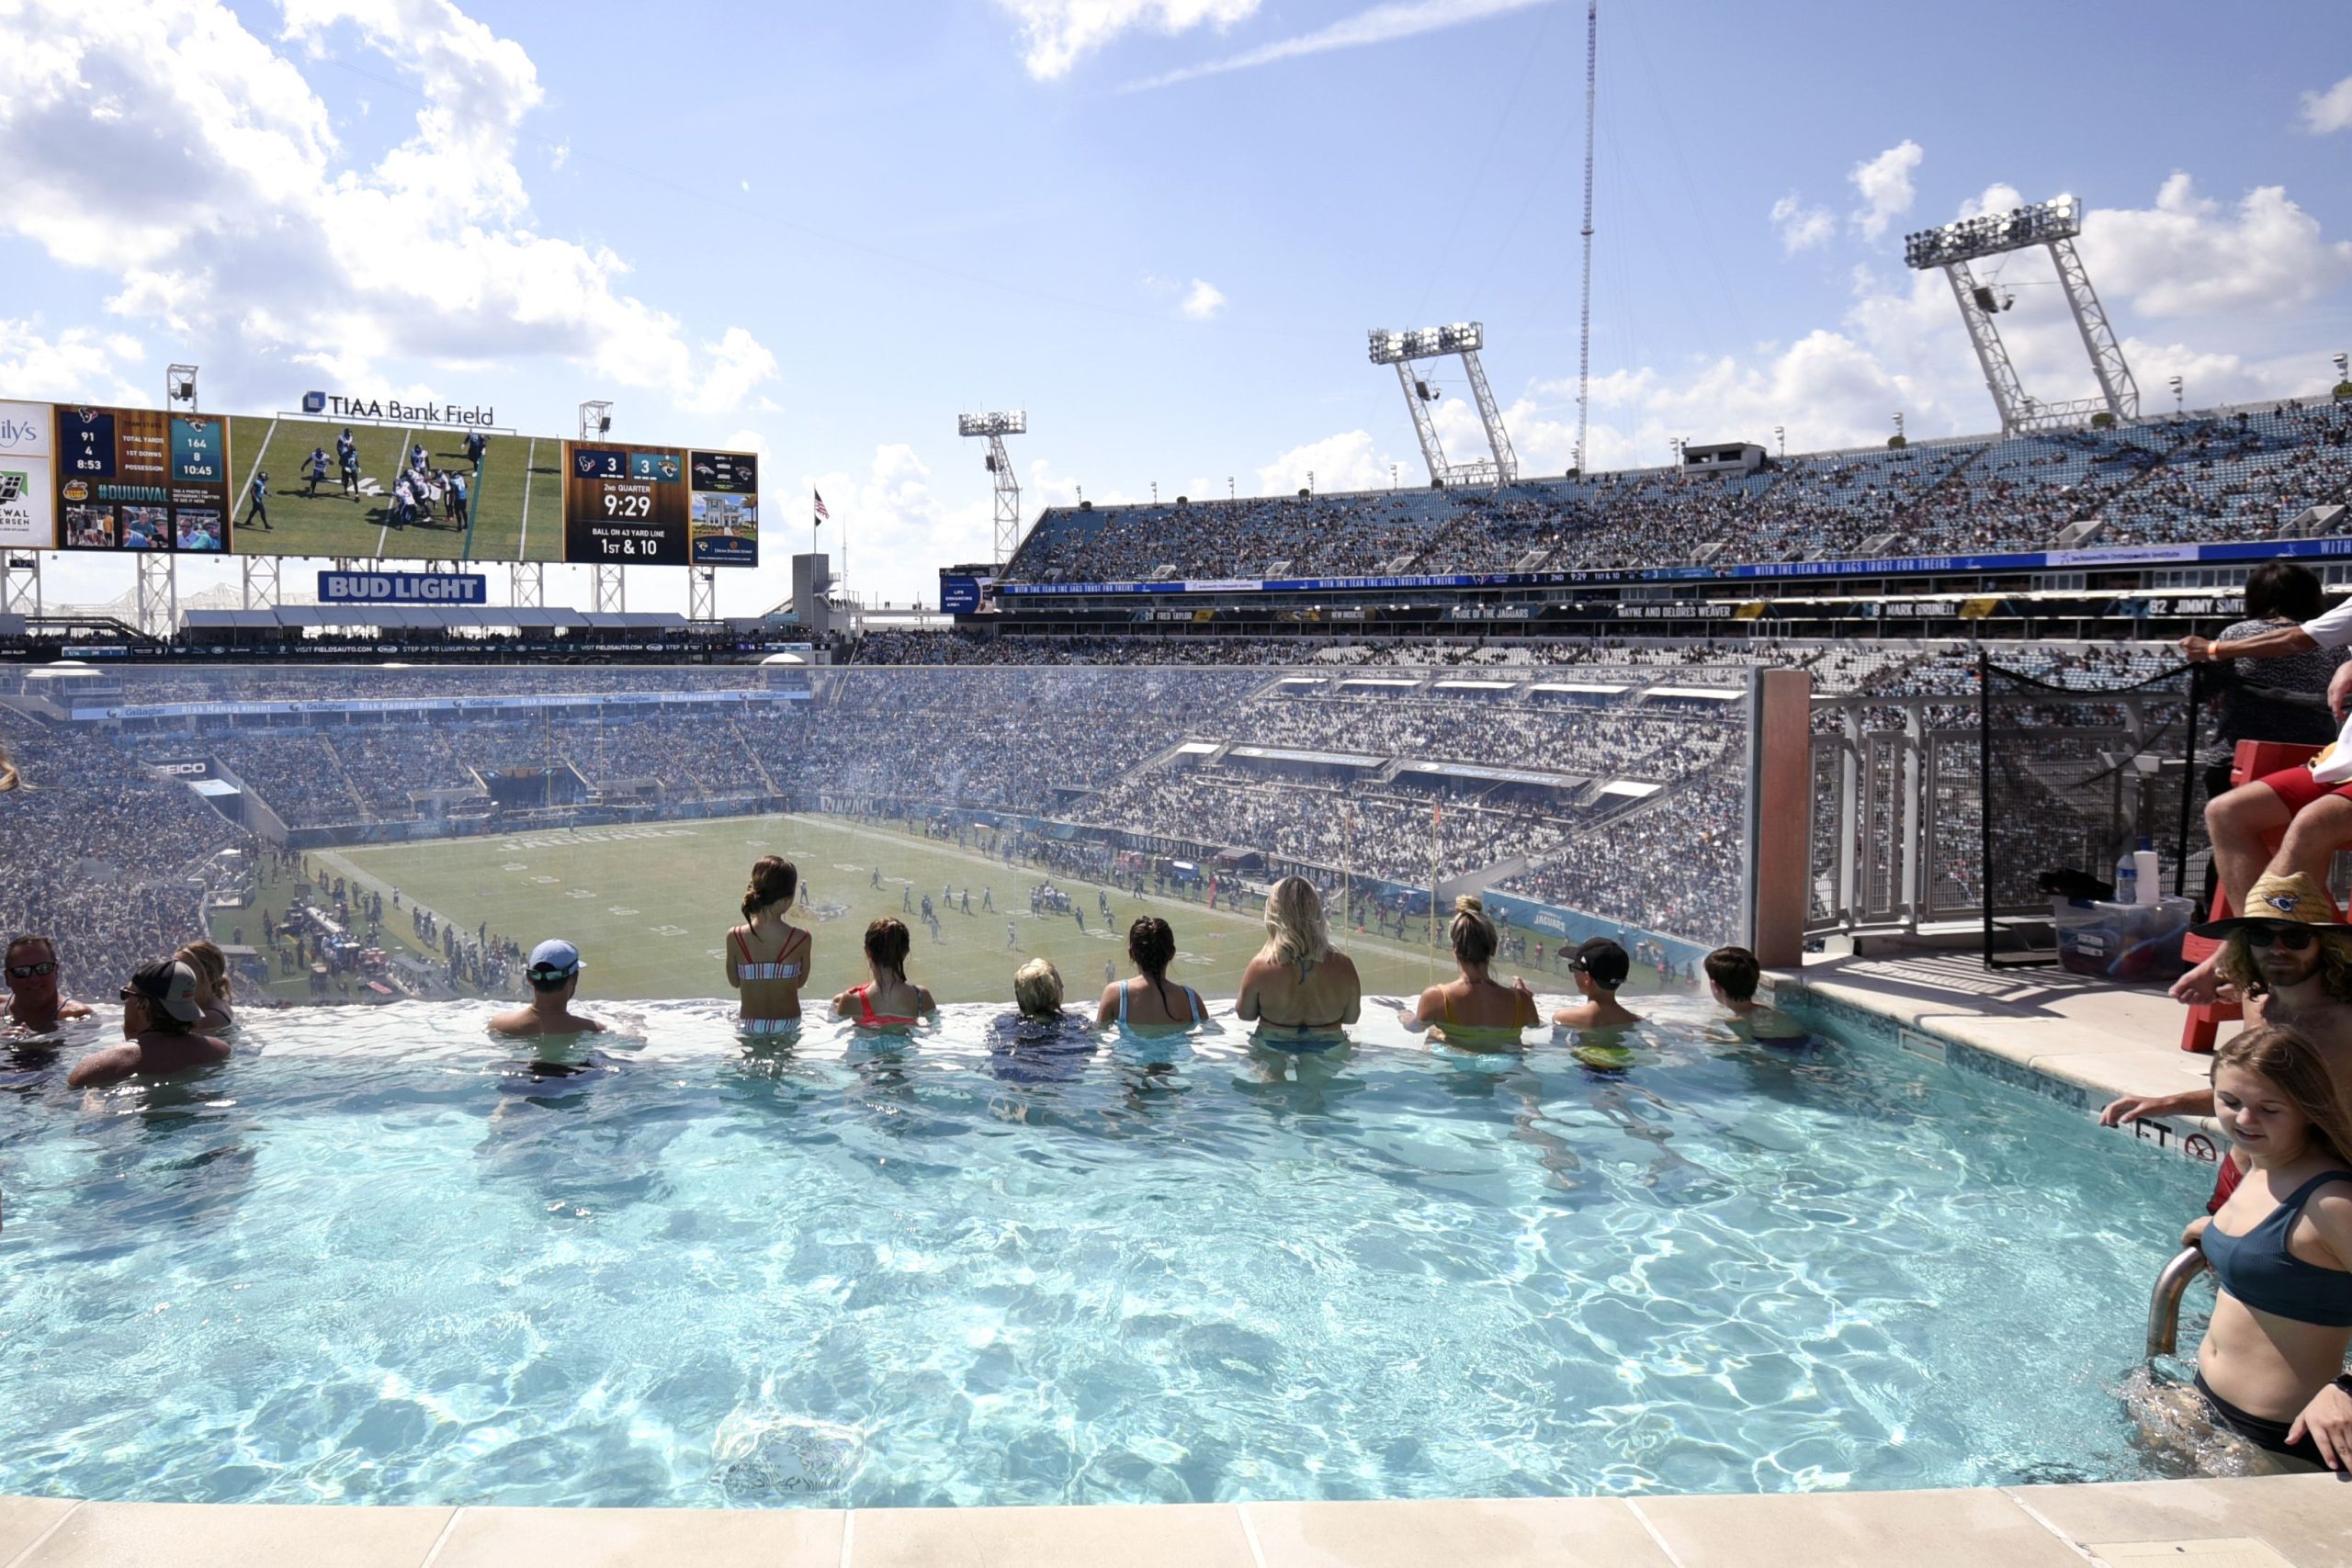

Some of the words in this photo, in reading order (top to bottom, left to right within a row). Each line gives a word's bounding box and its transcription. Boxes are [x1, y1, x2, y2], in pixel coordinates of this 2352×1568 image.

[328, 396, 383, 417] TIAA
[389, 400, 441, 422] Bank
[447, 404, 493, 425] Field
[81, 432, 95, 441] 91
[187, 438, 207, 448] 164
[85, 446, 93, 456] 4
[193, 452, 201, 461] 8
[76, 459, 102, 469] 8:53
[125, 464, 164, 472] POSSESSION
[607, 457, 617, 472] 3
[640, 459, 650, 474] 3
[184, 466, 212, 476] 10:45
[97, 484, 169, 502] #DUUUVAL
[617, 484, 651, 493] QUARTER
[605, 494, 650, 517] 9:29
[592, 527, 609, 536] BALL
[610, 528, 621, 536] ON
[630, 529, 649, 537] YARD
[650, 530, 665, 538] LINE
[601, 539, 621, 554] 1ST
[623, 540, 635, 555] &
[639, 540, 657, 555] 10
[2321, 540, 2352, 556] WITH
[1755, 566, 1774, 575] WITH
[1779, 565, 1792, 575] THE
[1797, 564, 1818, 574] TEAM
[1822, 563, 1838, 573] THE
[1841, 562, 1862, 572] JAGS
[1867, 561, 1893, 571] TRUST
[1897, 559, 1914, 570] FOR
[1918, 558, 1951, 570] THEIRS
[1532, 574, 1537, 582] 3
[1570, 572, 1587, 581] 9:29
[1318, 580, 1334, 588] WITH
[1336, 580, 1348, 588] THE
[1350, 579, 1364, 587] TEAM
[1366, 579, 1378, 587] THE
[1381, 578, 1396, 587] JAGS
[1397, 578, 1416, 586] TRUST
[1419, 577, 1431, 586] FOR
[1434, 576, 1455, 585] THEIRS
[328, 577, 392, 599] BUD
[395, 578, 479, 599] LIGHT
[1015, 585, 1027, 593] WITH
[1030, 585, 1040, 593] THE
[1084, 584, 1101, 592] TRUST
[1102, 584, 1113, 592] FOR
[1886, 604, 1913, 615] MARK
[1915, 603, 1956, 615] BRUNELL
[2149, 600, 2167, 614] 82
[2175, 599, 2213, 614] JIMMY
[1157, 612, 1171, 620] FRED
[1173, 612, 1193, 621] TAYLOR
[1453, 608, 1471, 619] PRIDE
[1473, 609, 1480, 619] OF
[1483, 608, 1495, 618] THE
[1497, 608, 1529, 619] JAGUARS
[1618, 607, 1643, 618] WAYNE
[1645, 607, 1661, 617] AND
[1663, 607, 1696, 617] DELORES
[1698, 606, 1731, 617] WEAVER
[358, 701, 378, 709] Risk
[382, 700, 438, 709] Management
[470, 698, 504, 707] Gallagher
[520, 697, 537, 705] Risk
[126, 706, 165, 717] Gallagher
[182, 705, 203, 713] Risk
[307, 703, 346, 712] Gallagher
[1533, 914, 1566, 932] JAGUARS
